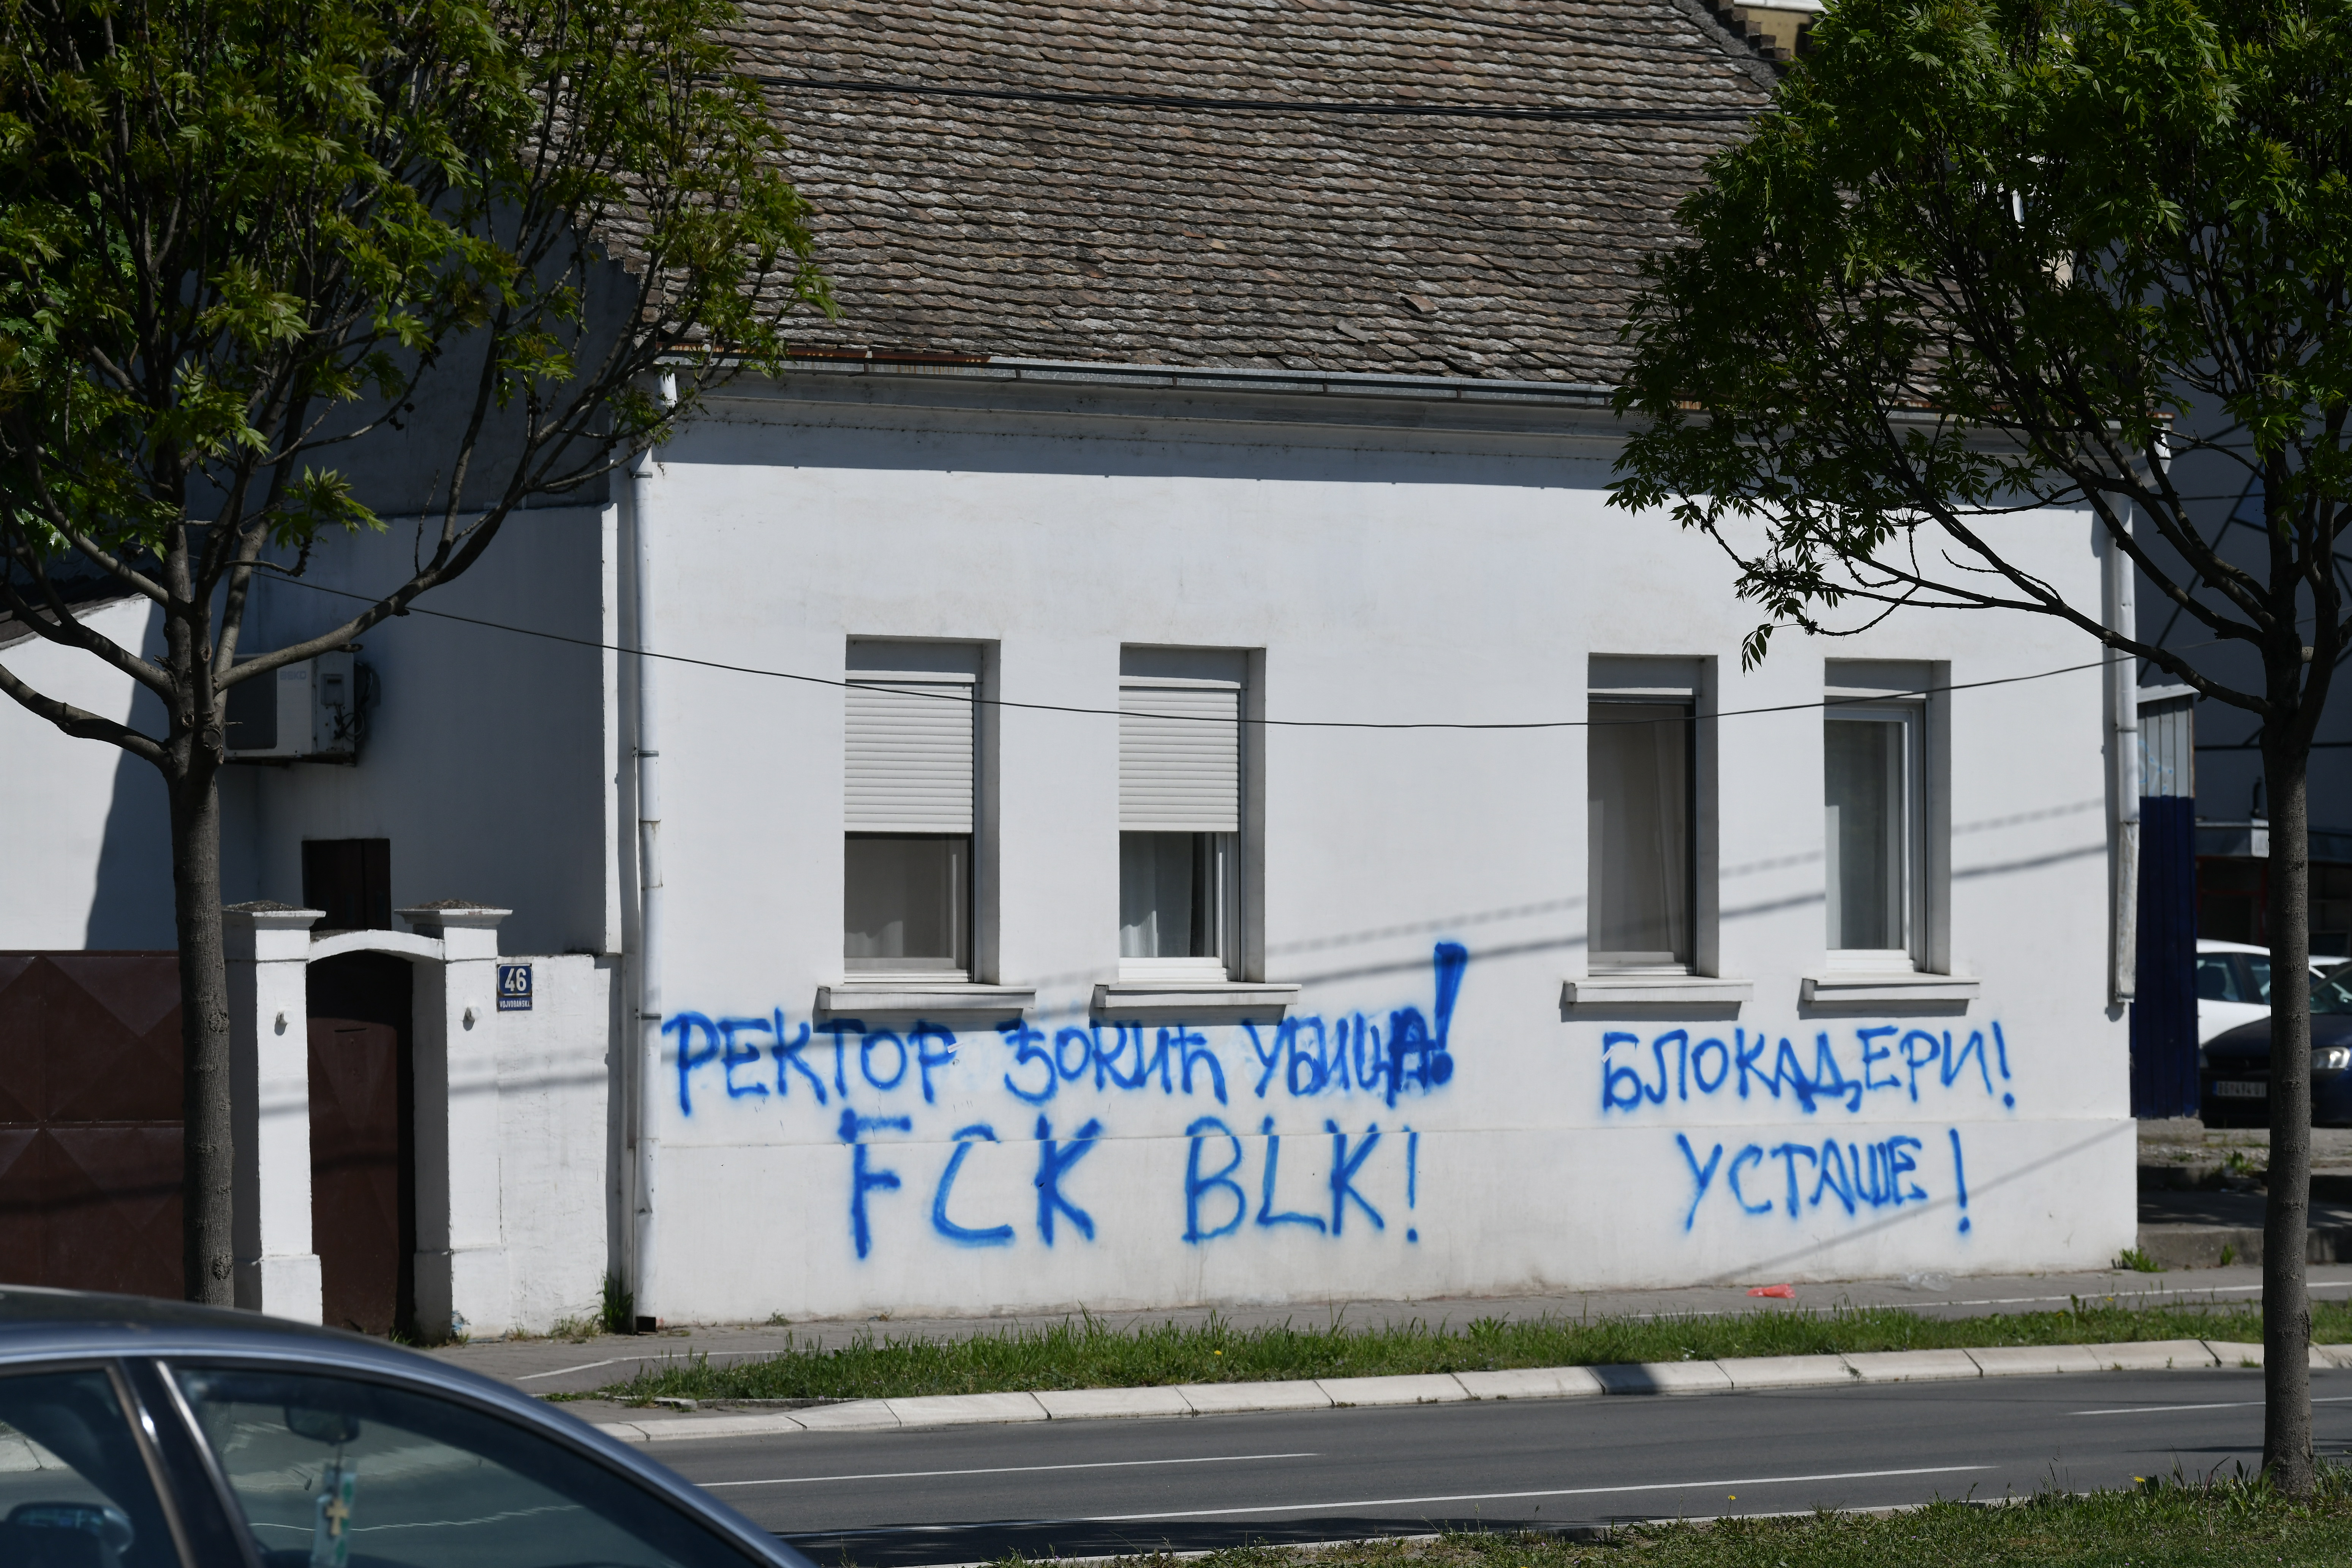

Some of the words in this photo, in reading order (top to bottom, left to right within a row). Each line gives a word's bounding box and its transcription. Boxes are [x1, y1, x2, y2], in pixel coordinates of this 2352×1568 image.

[280, 670, 307, 680] BEKO
[504, 967, 526, 992] 46
[661, 1007, 957, 1117] РЕКТОР
[1601, 1020, 2015, 1114] БЛОКАДЕРИ!
[837, 1107, 1103, 1260] FCK
[1181, 1115, 1419, 1246] BLK!
